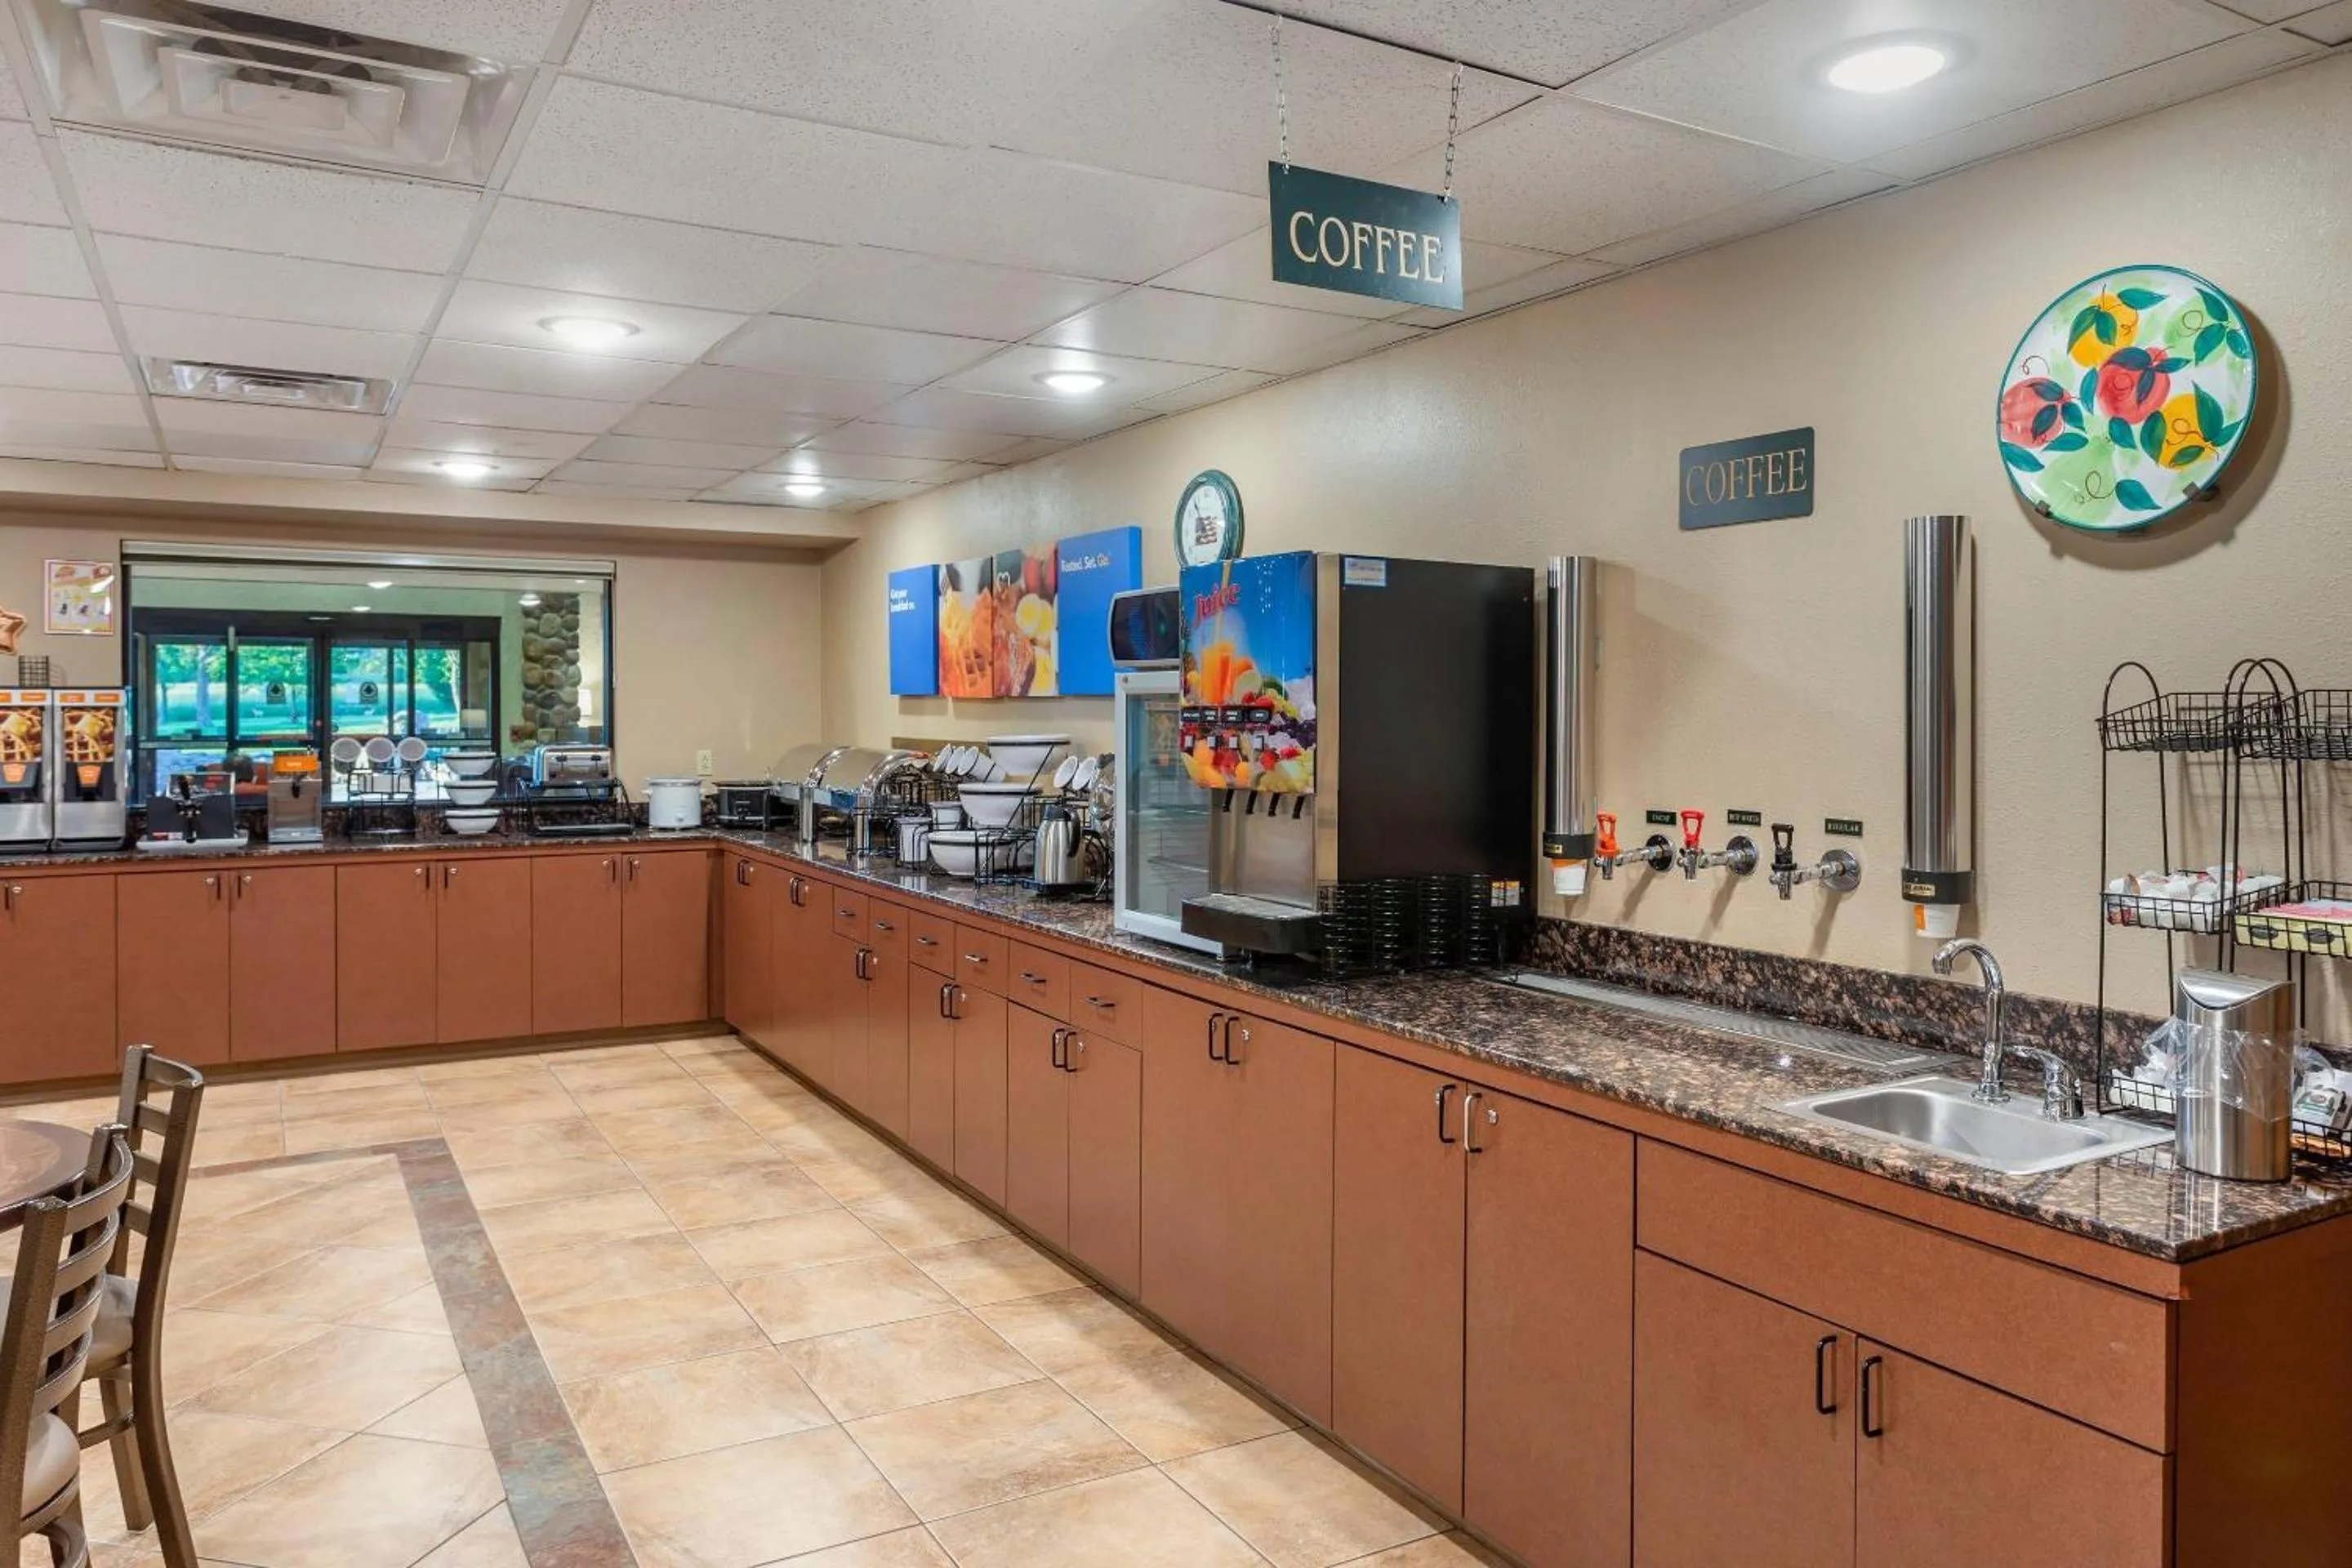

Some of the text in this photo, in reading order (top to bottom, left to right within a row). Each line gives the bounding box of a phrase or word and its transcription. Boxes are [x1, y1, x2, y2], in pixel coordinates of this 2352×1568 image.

[1290, 211, 1446, 283] COFFEE
[1686, 448, 1807, 506] COFFEE
[1193, 582, 1241, 627] Juice
